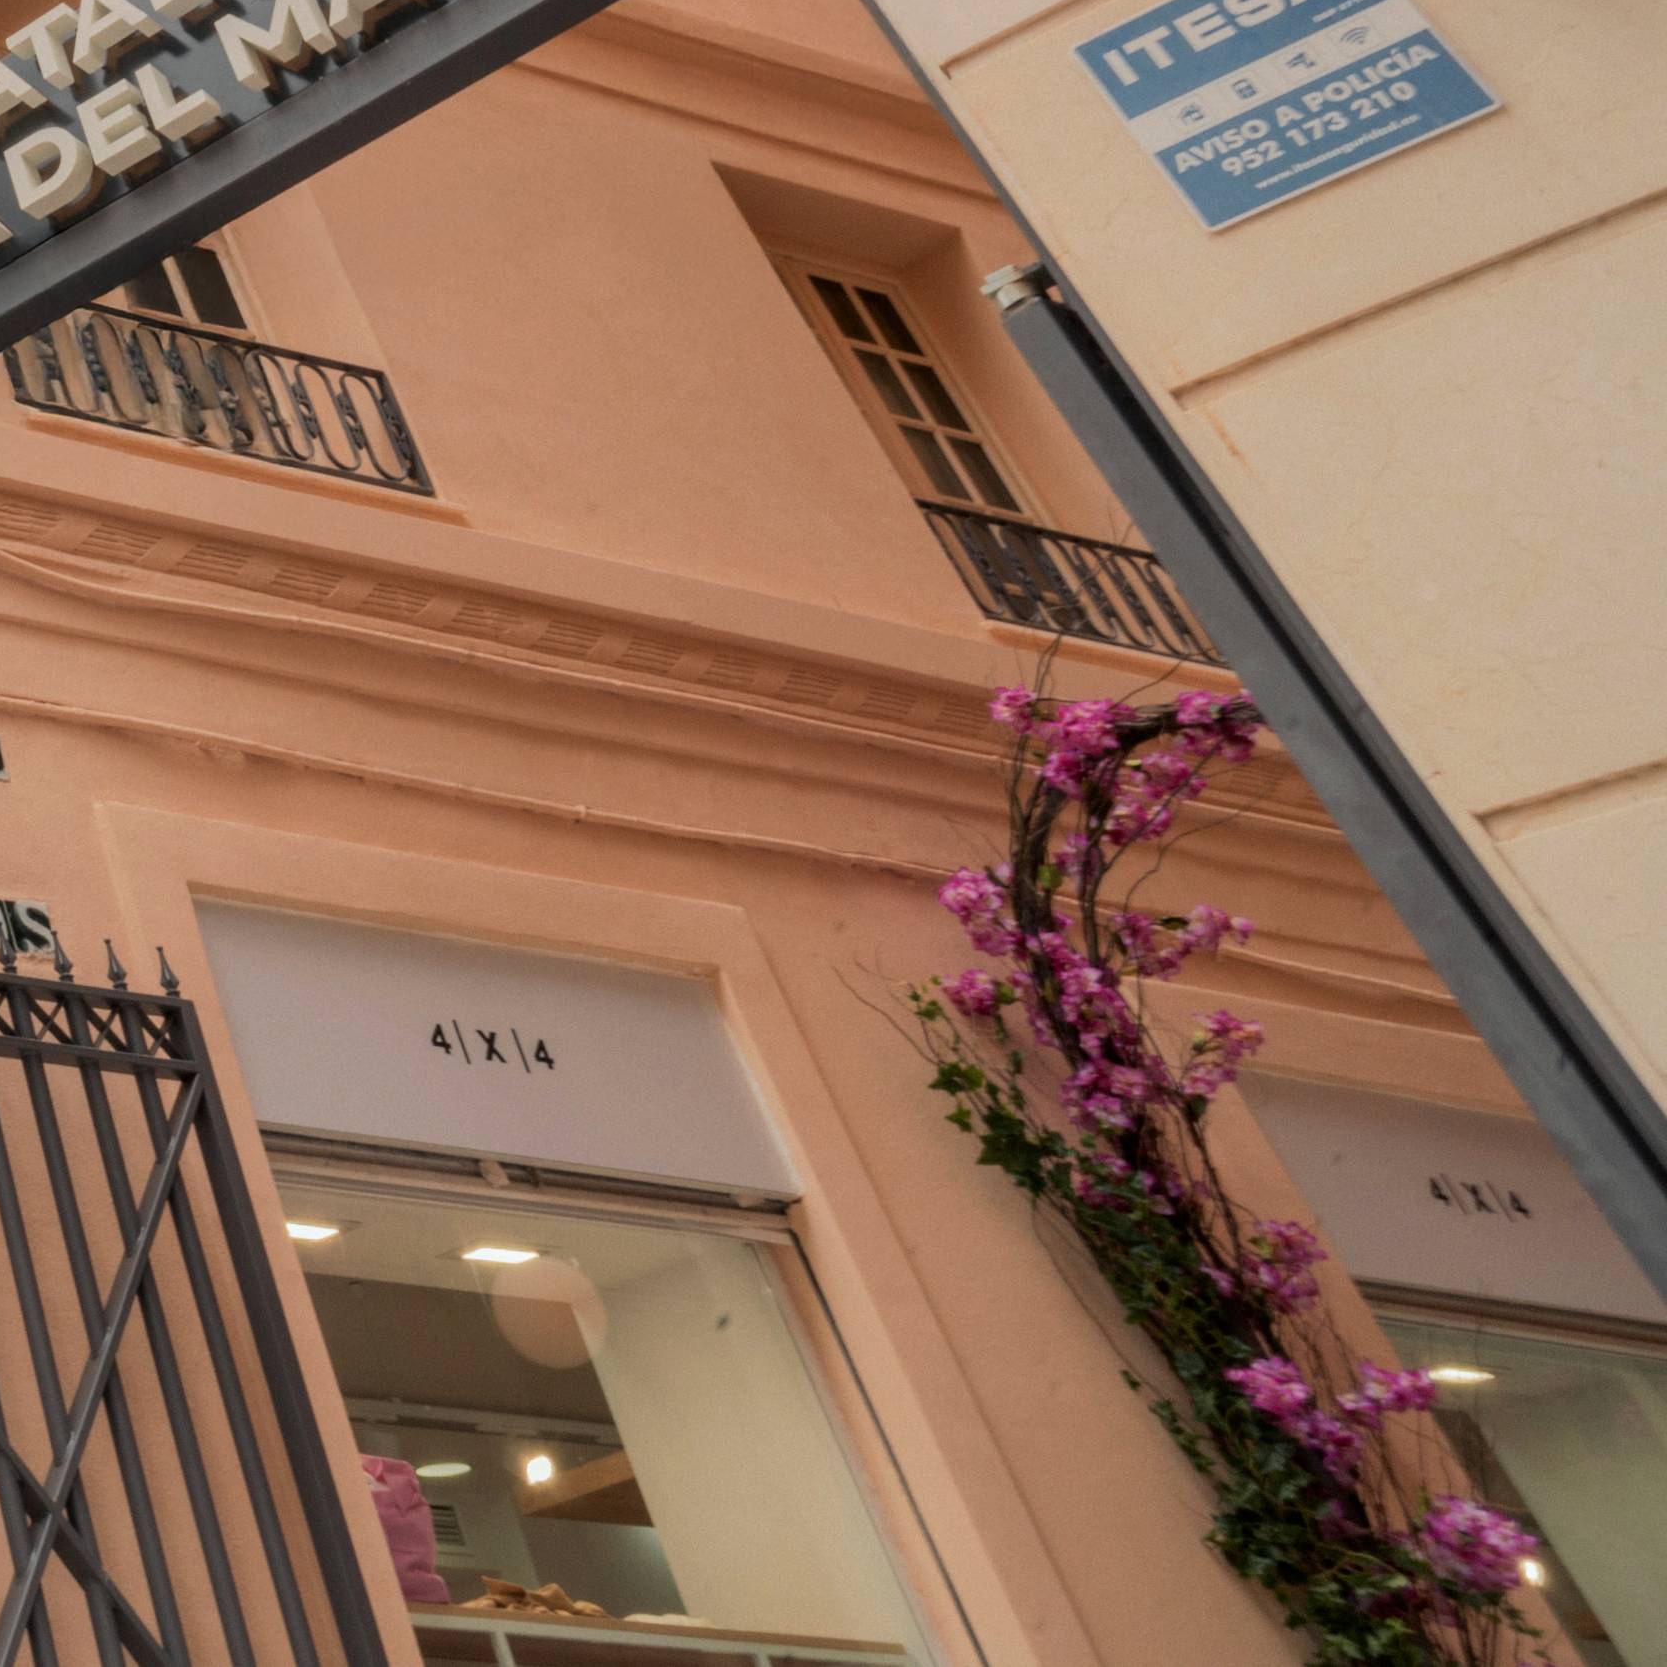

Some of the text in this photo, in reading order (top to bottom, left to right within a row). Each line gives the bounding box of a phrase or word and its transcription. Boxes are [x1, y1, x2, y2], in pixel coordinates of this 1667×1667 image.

[4, 63, 222, 221] DEL
[1174, 44, 1440, 174] AVISO A POLICÍA
[1221, 81, 1417, 176] 952 173 210
